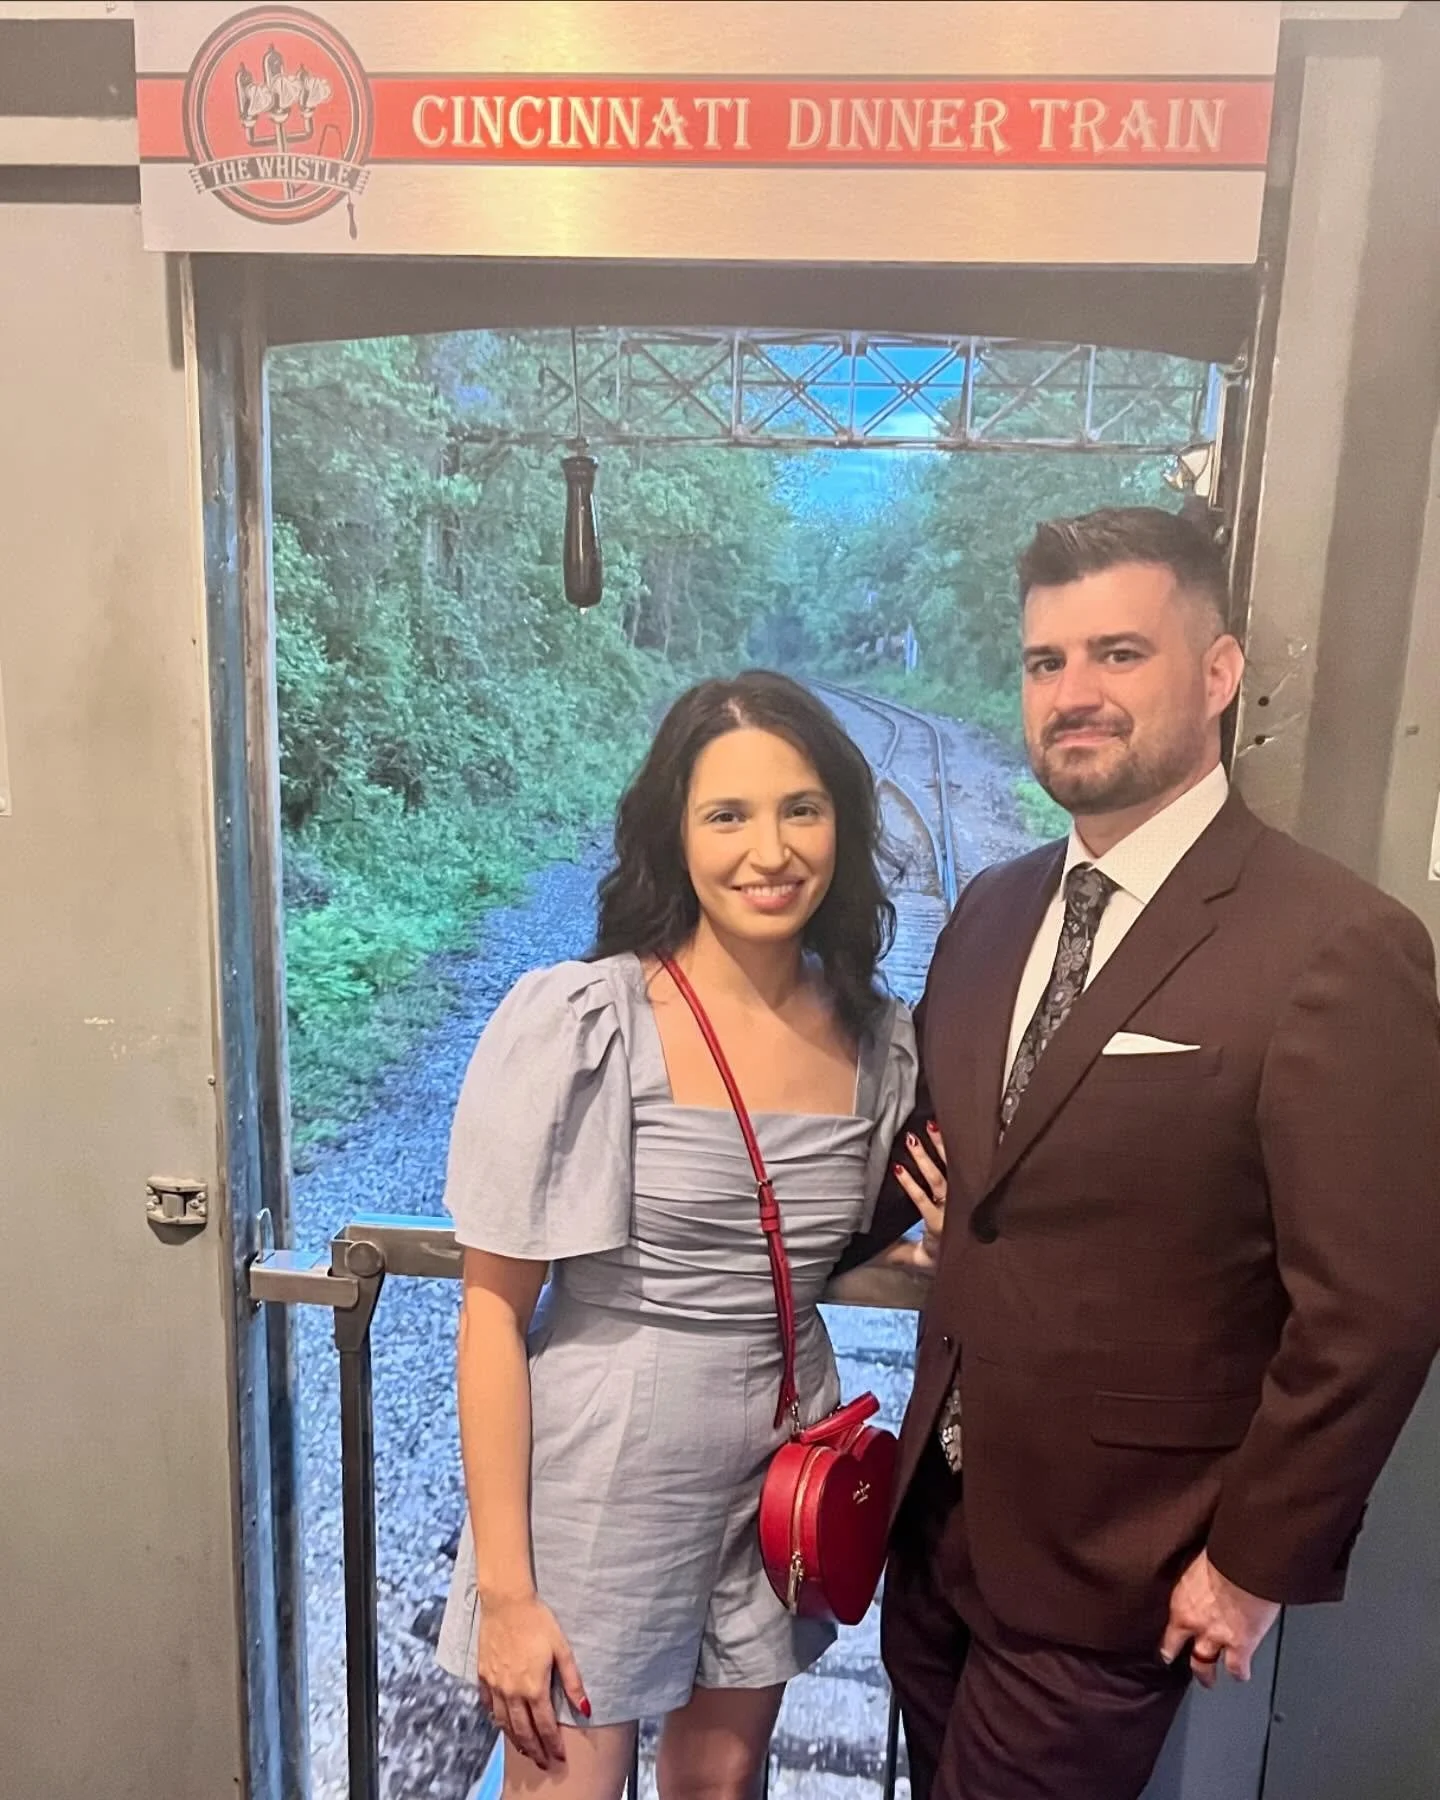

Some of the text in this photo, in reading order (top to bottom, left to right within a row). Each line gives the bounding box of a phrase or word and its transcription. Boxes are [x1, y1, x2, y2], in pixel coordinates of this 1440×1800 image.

[411, 95, 1225, 153] CINCINNATI DINNER TRAIN
[208, 156, 350, 187] THE WHISTLE
